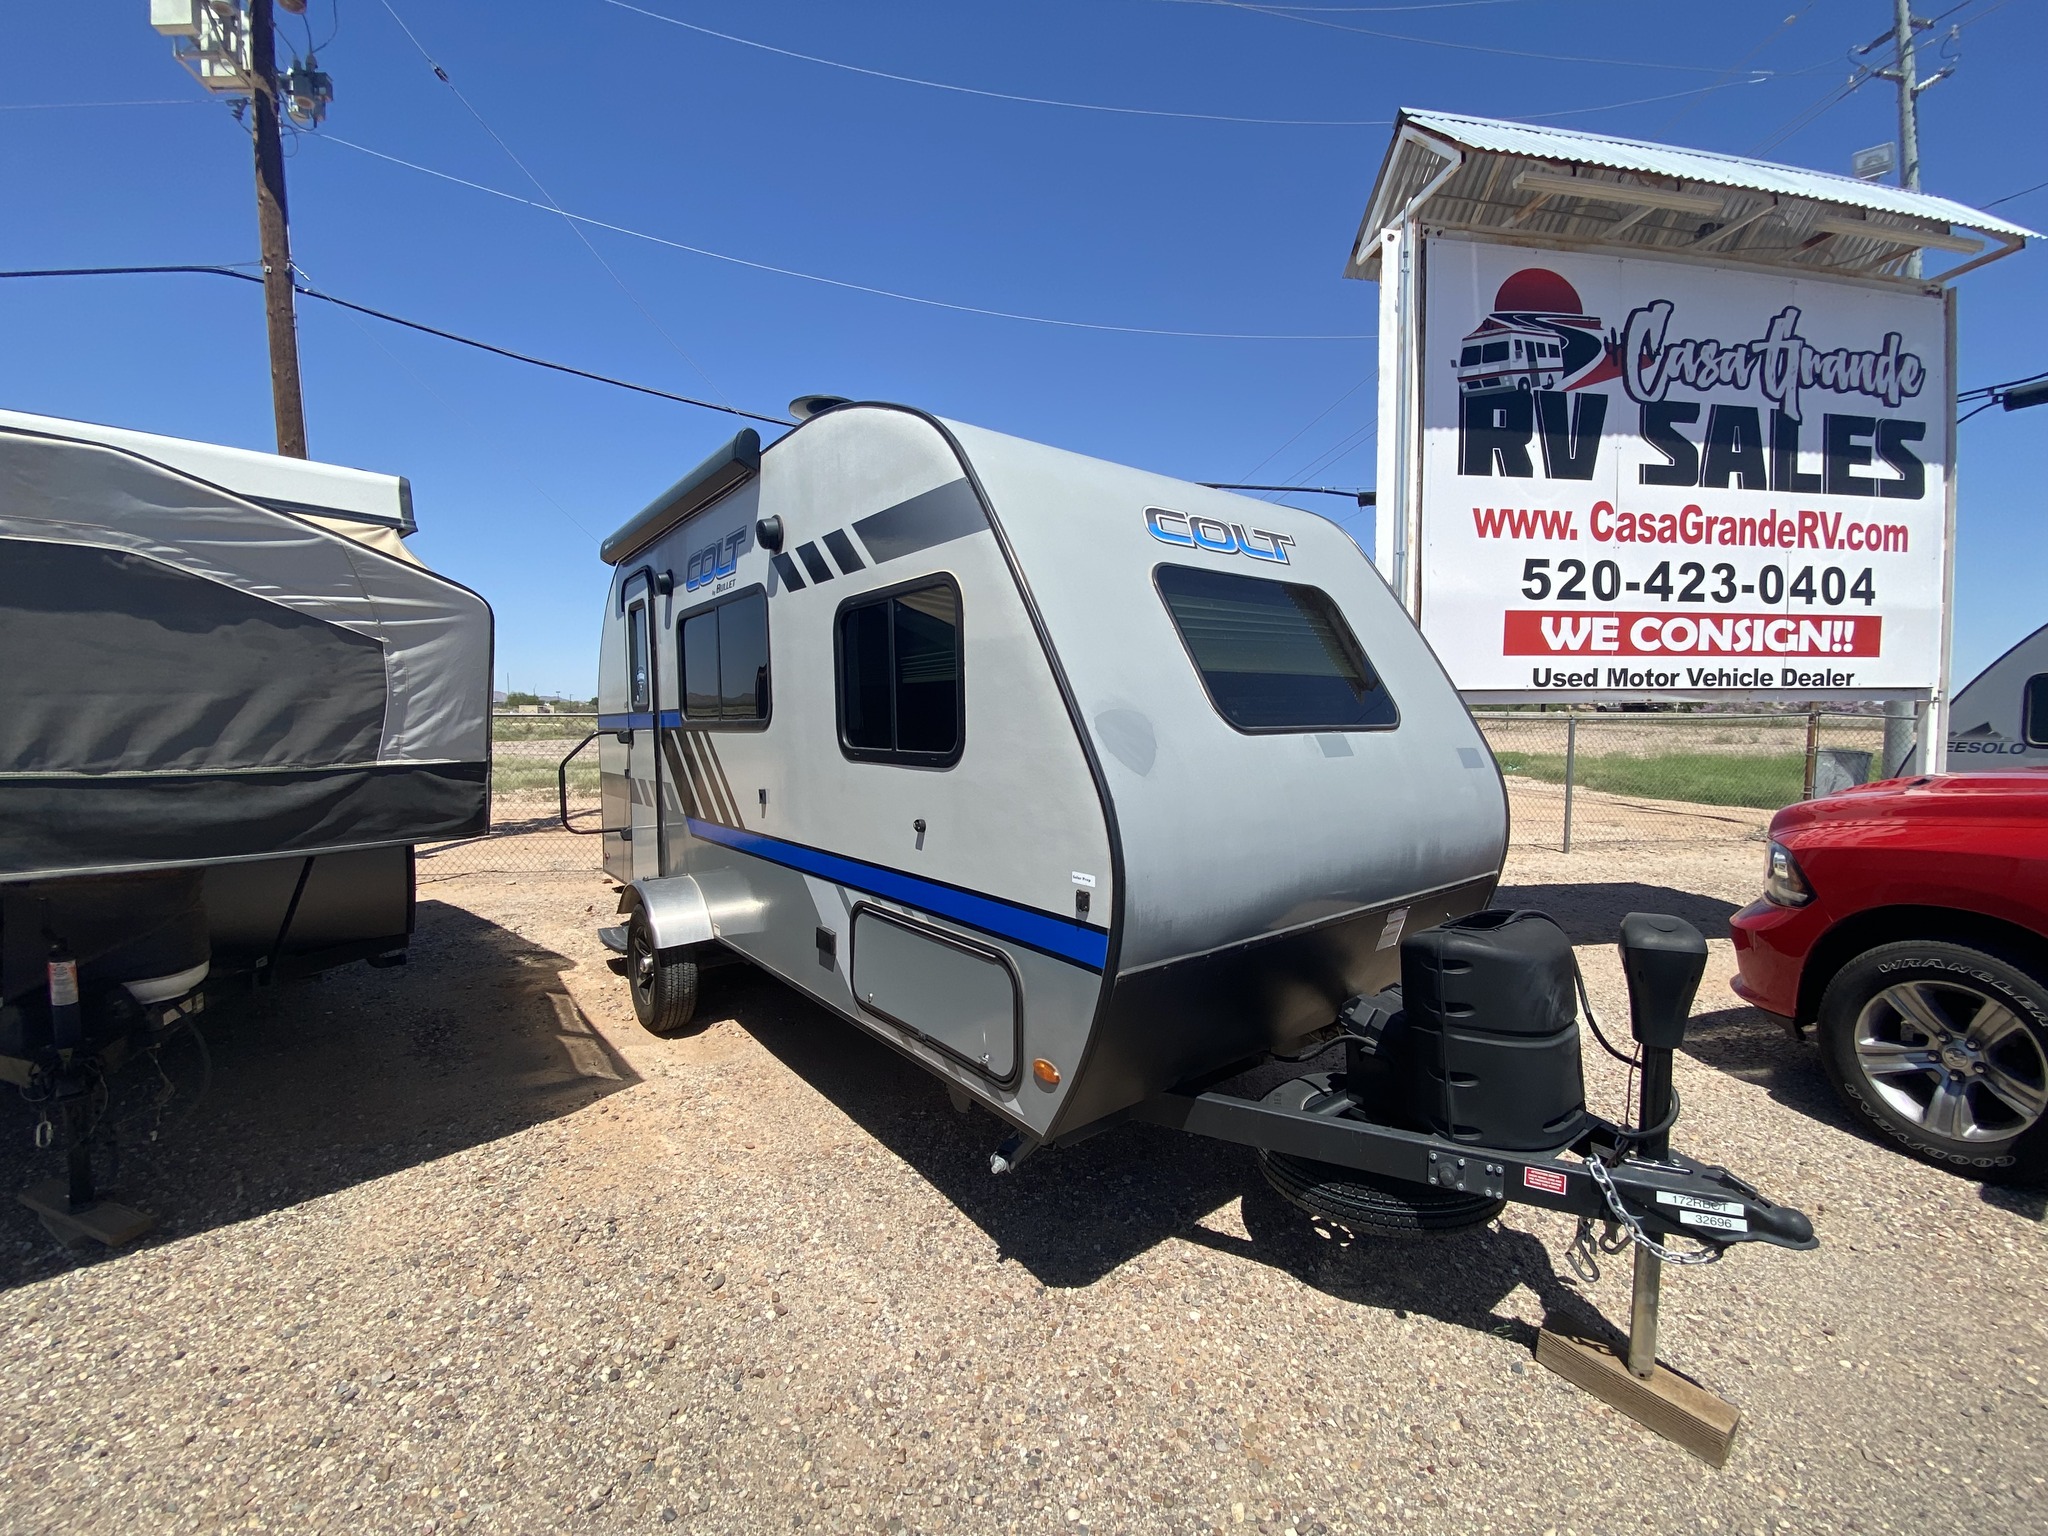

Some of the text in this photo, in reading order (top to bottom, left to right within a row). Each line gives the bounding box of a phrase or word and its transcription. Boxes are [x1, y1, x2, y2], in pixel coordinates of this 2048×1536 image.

[1622, 299, 1926, 424] Casa Grande
[1458, 386, 1926, 500] RV SALES
[1142, 505, 1296, 566] COLT
[1472, 500, 1909, 552] www. CasaGrandeRV.com
[686, 525, 747, 593] COLT
[1521, 558, 1876, 606] 520-423-0404
[1540, 616, 1855, 652] WE CONSIGN!!
[1532, 667, 1855, 688] Used Motor Vehicle Dealer
[1695, 1214, 1732, 1228] 32696
